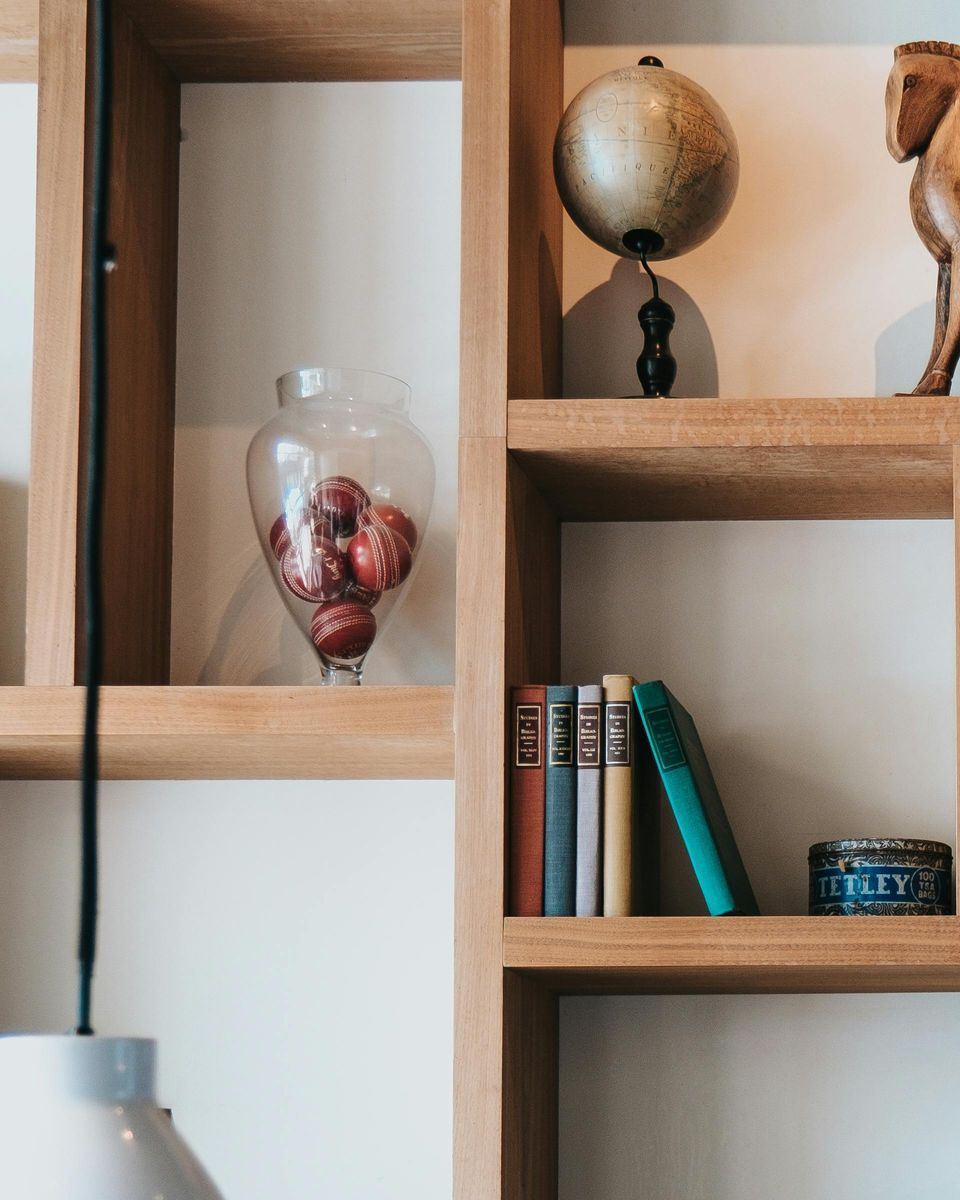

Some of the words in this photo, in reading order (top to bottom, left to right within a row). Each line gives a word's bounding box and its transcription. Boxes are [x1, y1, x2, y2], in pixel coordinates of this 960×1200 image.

[919, 871, 935, 881] 100
[818, 874, 910, 898] TETLEY
[918, 890, 936, 900] BAGS
